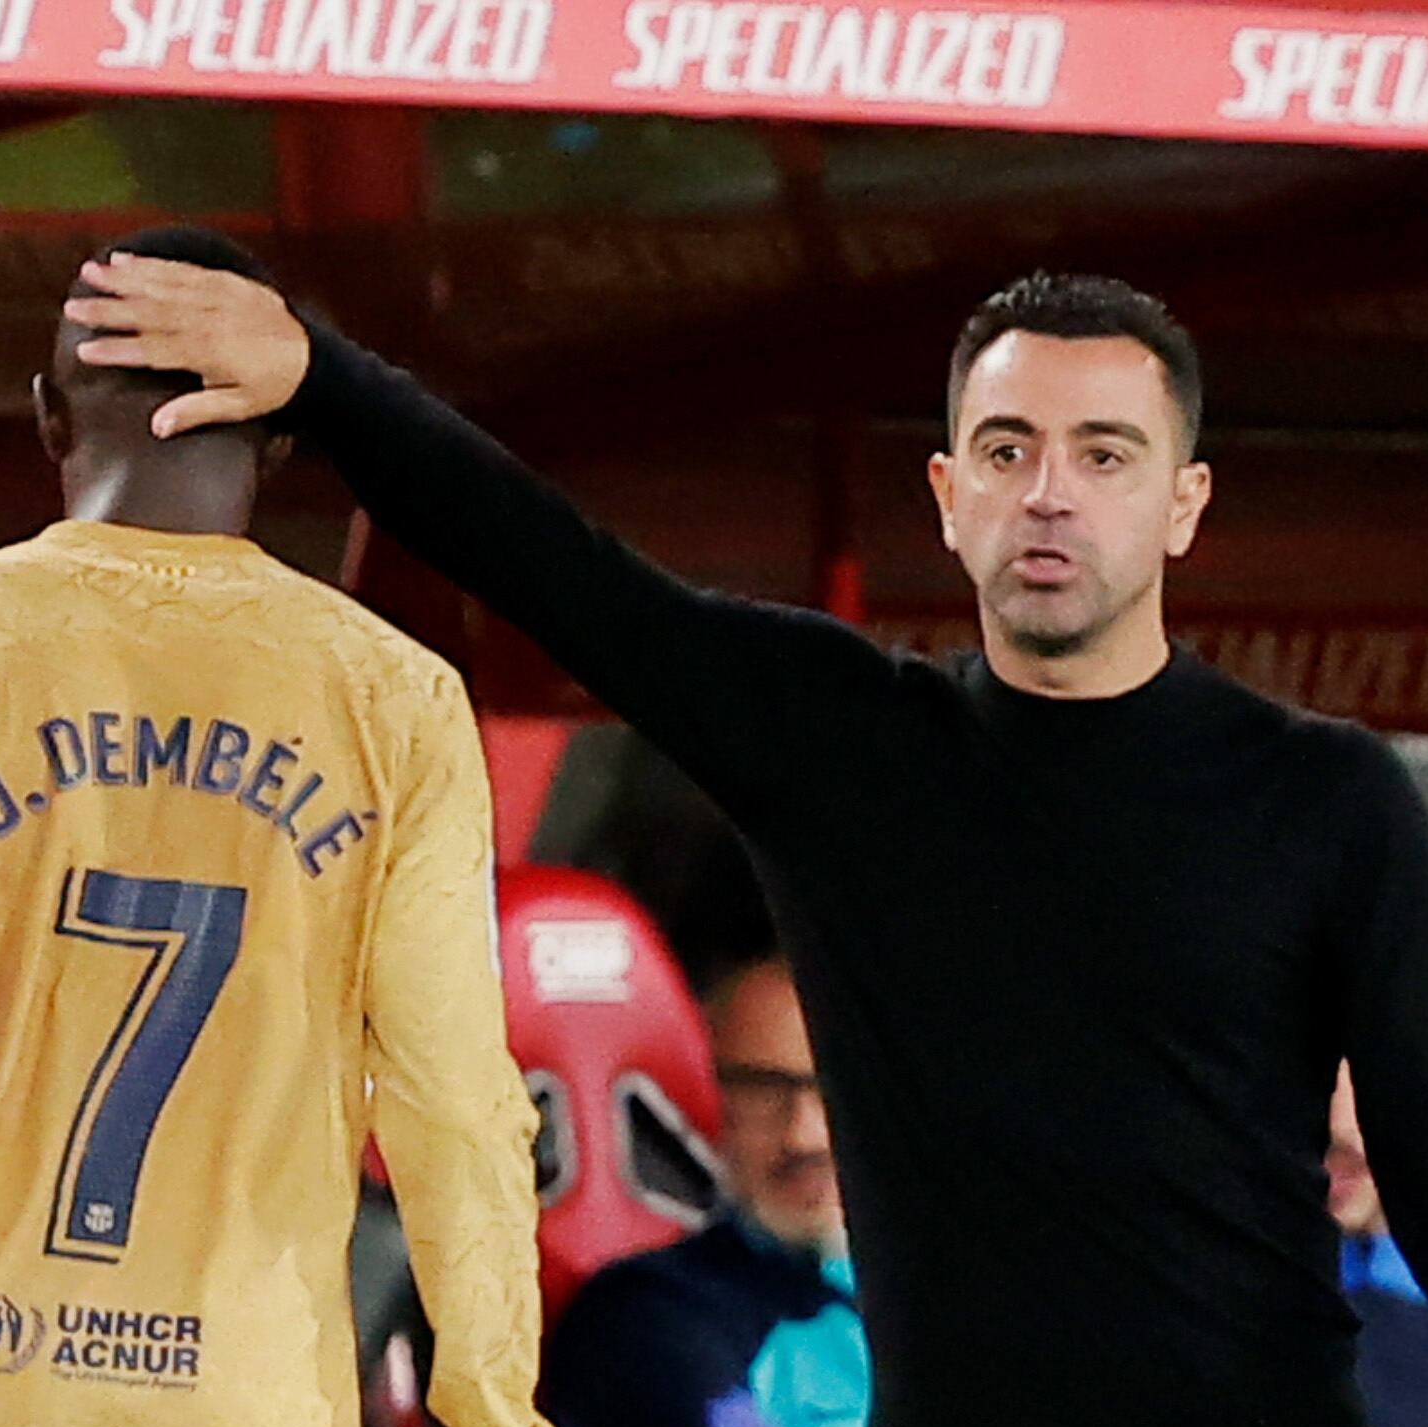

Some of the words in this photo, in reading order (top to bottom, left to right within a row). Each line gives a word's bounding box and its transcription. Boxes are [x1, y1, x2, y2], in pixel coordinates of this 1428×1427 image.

[97, 0, 553, 84] SPECIALIZED
[610, 1, 1065, 108] SPECIALIZED
[44, 867, 248, 1264] 7
[52, 1337, 200, 1376] ACNUR
[58, 1303, 203, 1344] UNHCR
